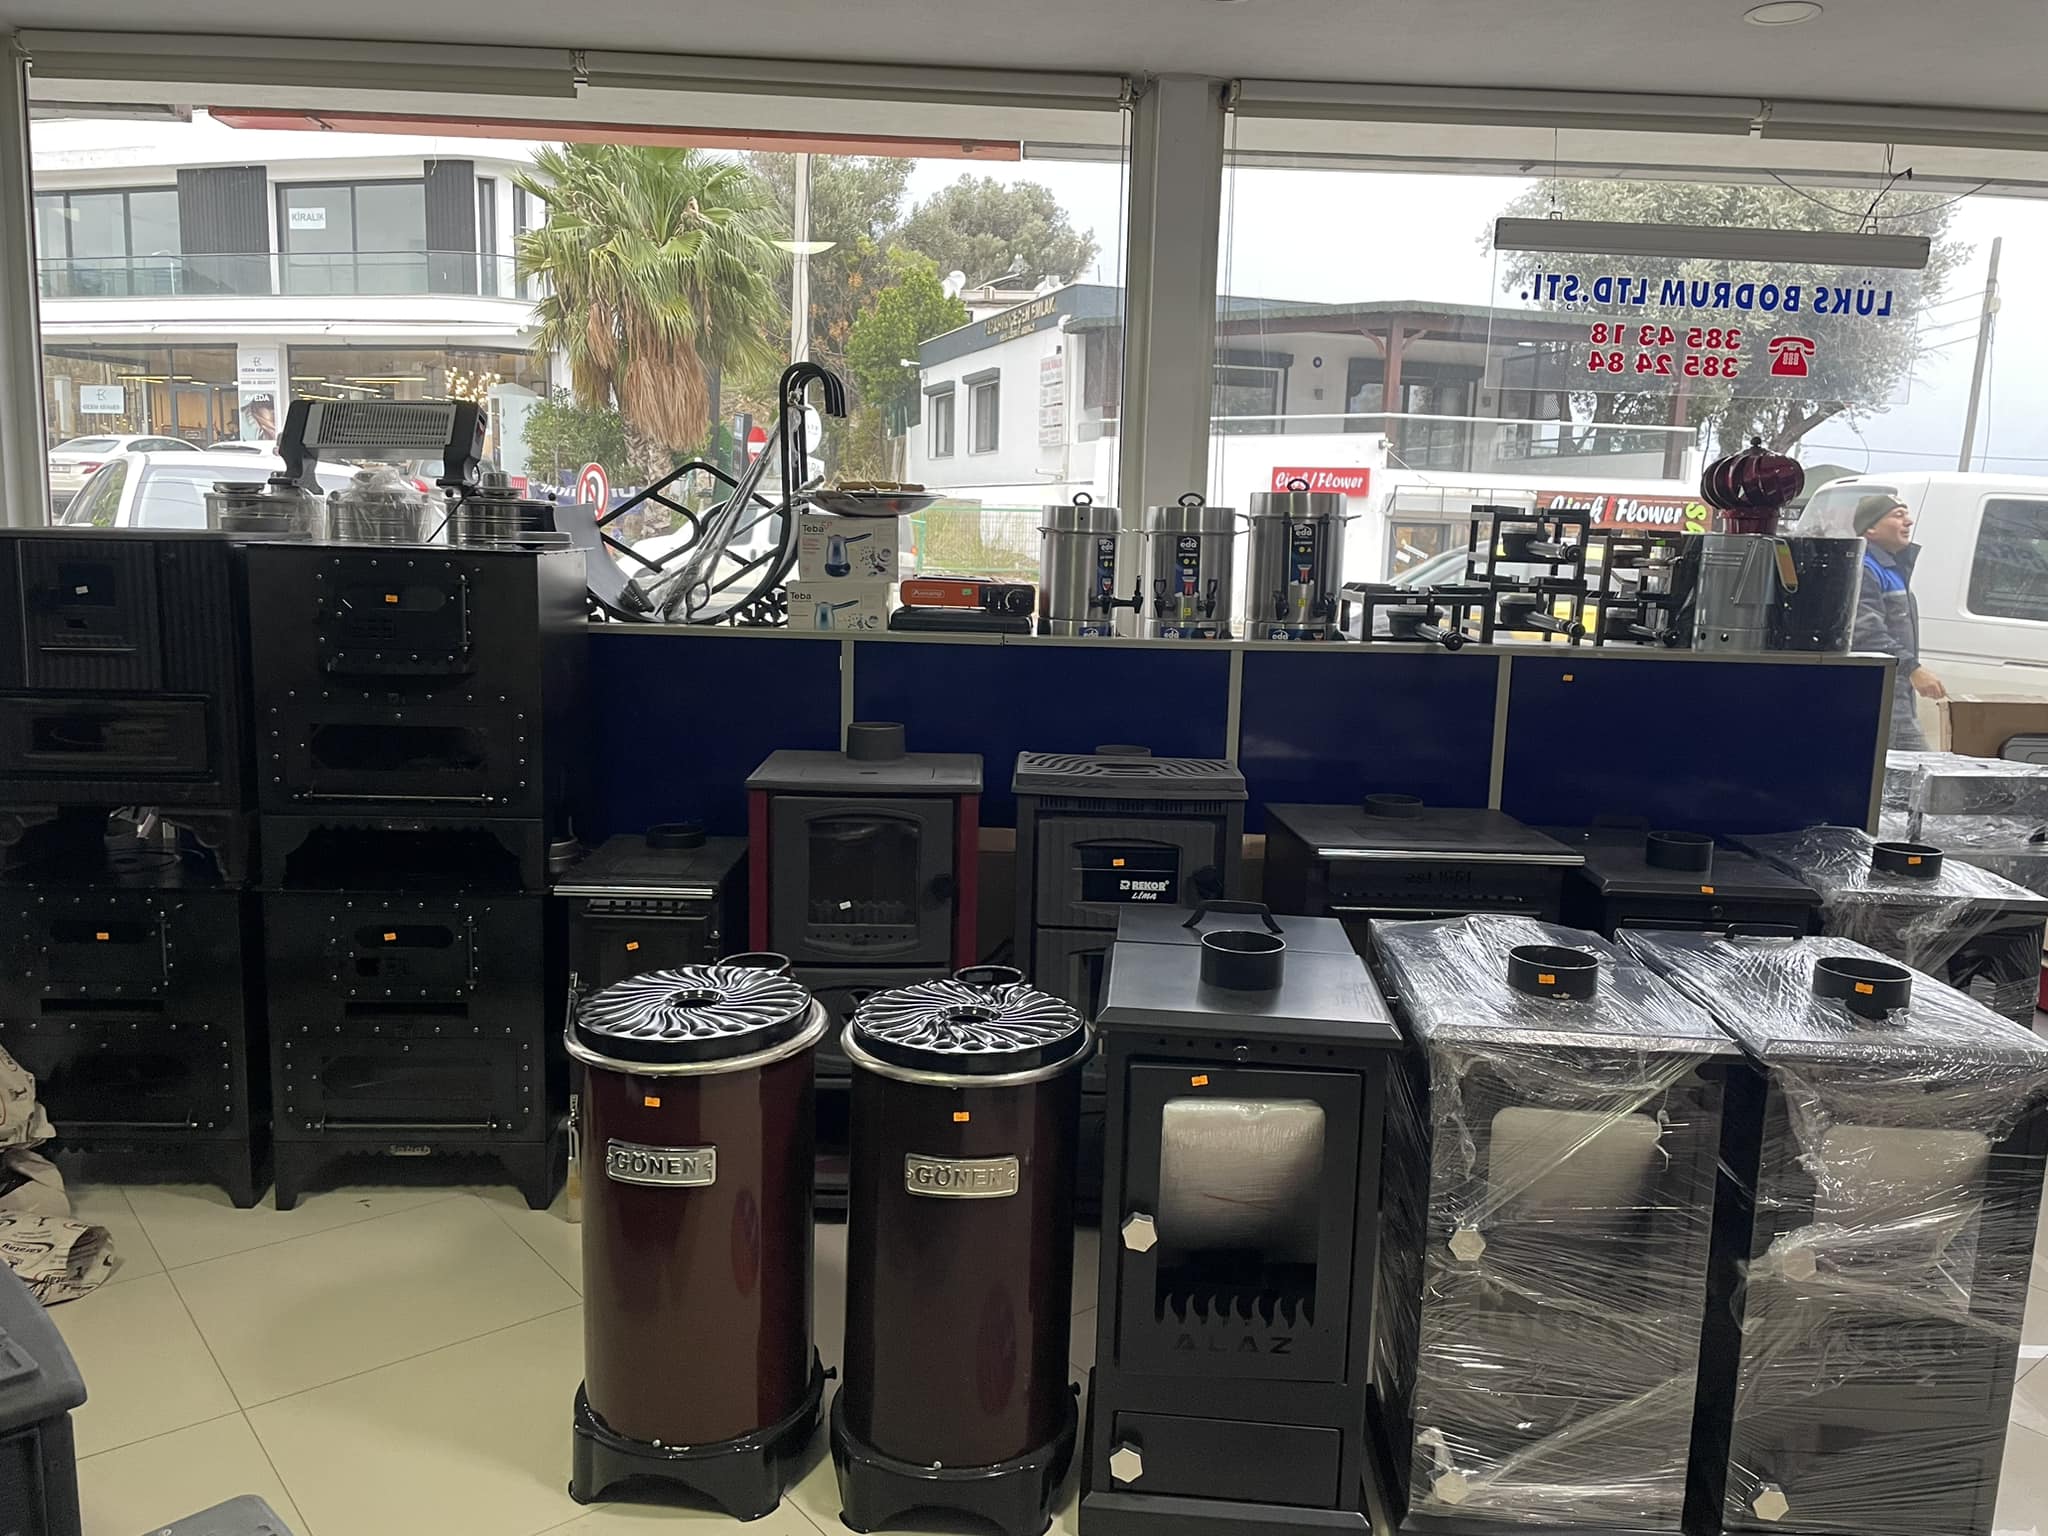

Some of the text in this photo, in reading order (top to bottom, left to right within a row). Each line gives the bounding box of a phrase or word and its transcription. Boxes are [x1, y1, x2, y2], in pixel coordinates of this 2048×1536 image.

[790, 591, 812, 600] Teba
[614, 1150, 700, 1176] GÖNEN
[915, 1165, 1004, 1187] GÖNEN
[1174, 1333, 1293, 1354] ALAZ
